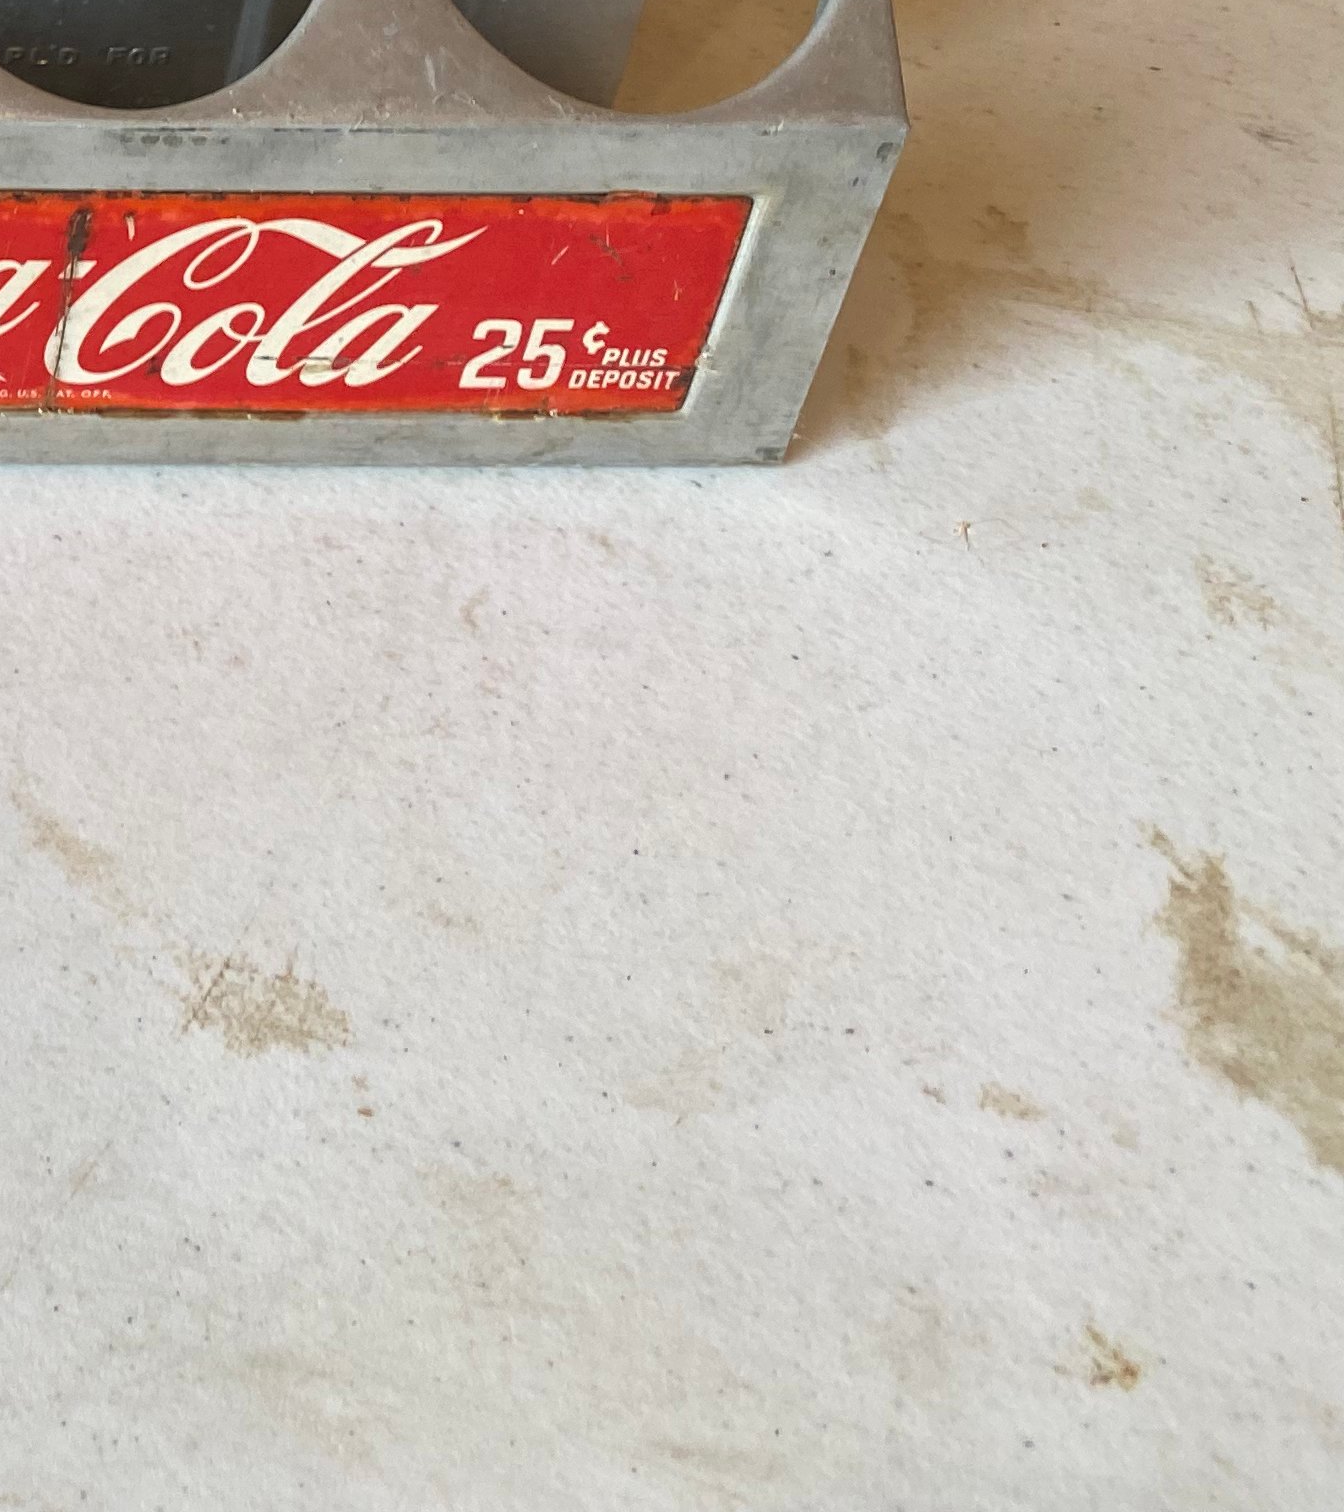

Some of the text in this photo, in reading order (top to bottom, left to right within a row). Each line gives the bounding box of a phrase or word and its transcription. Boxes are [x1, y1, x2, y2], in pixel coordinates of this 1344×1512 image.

[106, 44, 173, 66] FOR
[600, 347, 668, 368] PLUS
[568, 368, 681, 392] DEPOSIT
